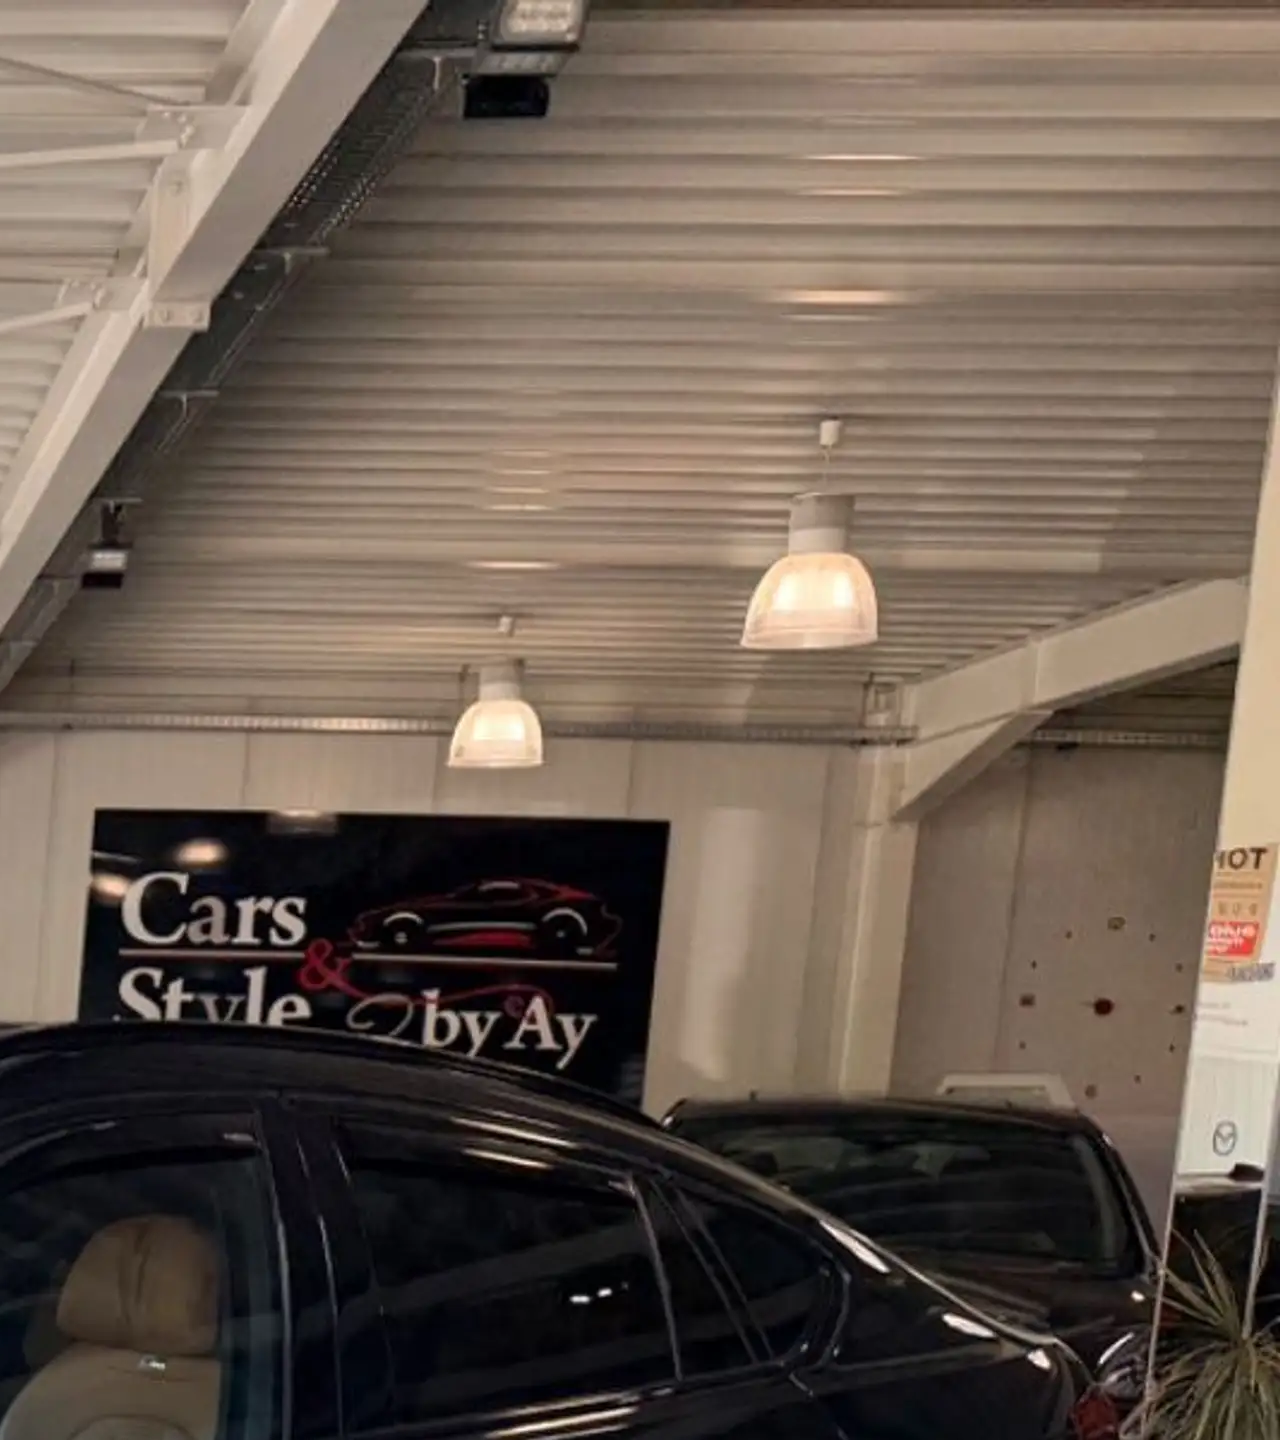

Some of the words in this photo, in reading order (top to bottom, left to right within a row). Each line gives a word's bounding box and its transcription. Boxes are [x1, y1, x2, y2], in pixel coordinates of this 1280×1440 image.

[121, 872, 307, 946] Cars
[422, 989, 502, 1060] by
[504, 996, 598, 1071] Ay
